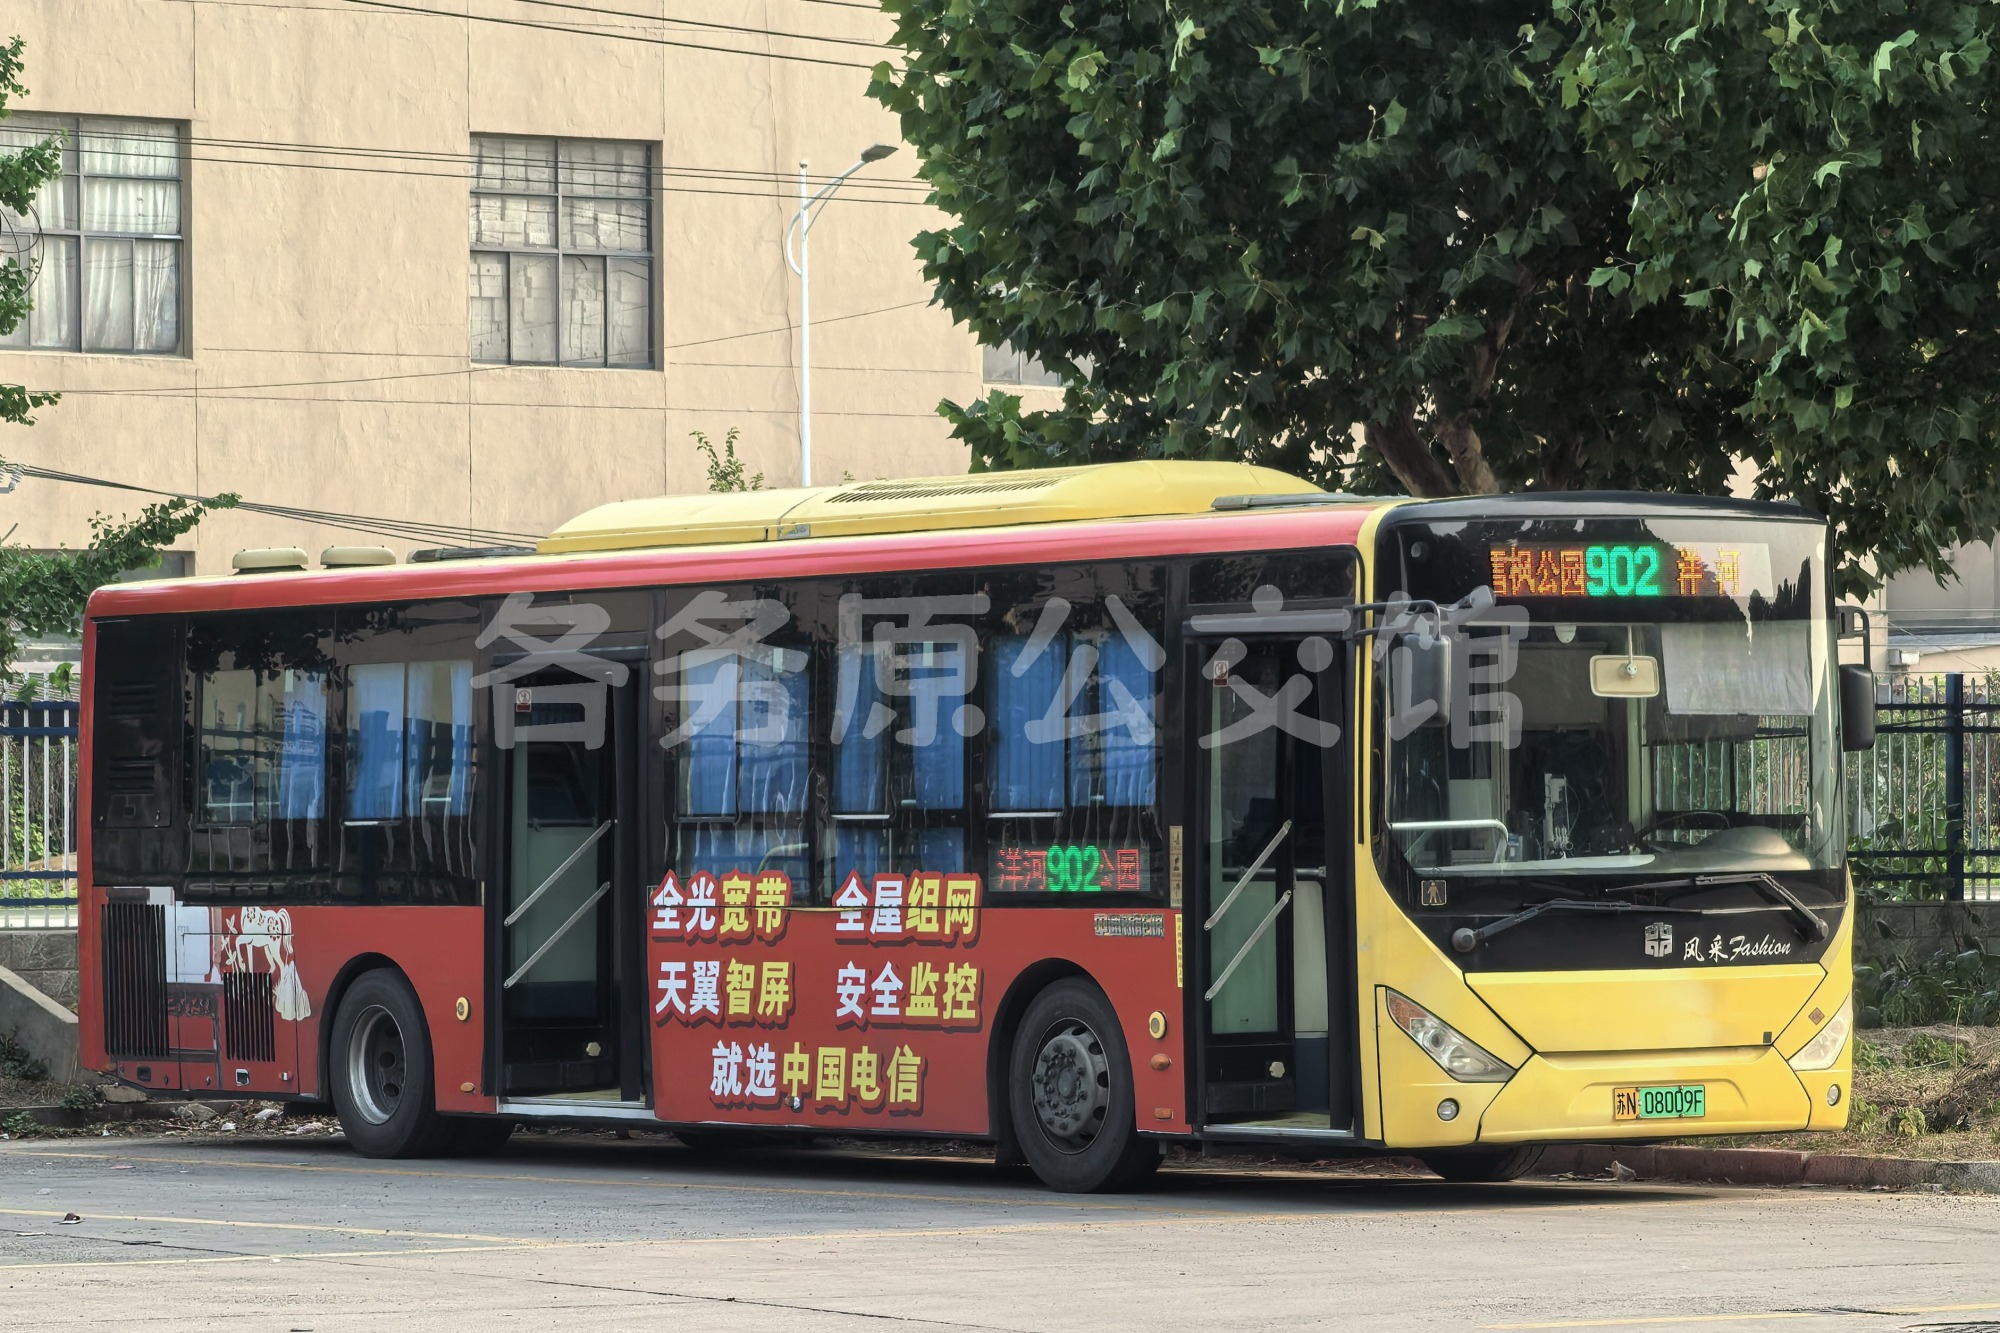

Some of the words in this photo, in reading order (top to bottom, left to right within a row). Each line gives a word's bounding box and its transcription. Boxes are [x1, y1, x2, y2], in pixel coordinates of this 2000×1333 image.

[1585, 545, 1660, 597] 902
[997, 847, 1048, 891] 洋河
[1048, 845, 1101, 892] 902
[653, 875, 787, 934] 全光宽带
[836, 876, 976, 935] 全屋组网
[1683, 934, 1728, 963] 风采
[1729, 933, 1791, 962] Fashion
[655, 957, 790, 1017] 天翼智屏
[836, 960, 978, 1020] 安全监控
[709, 1040, 921, 1103] 就选中国电信
